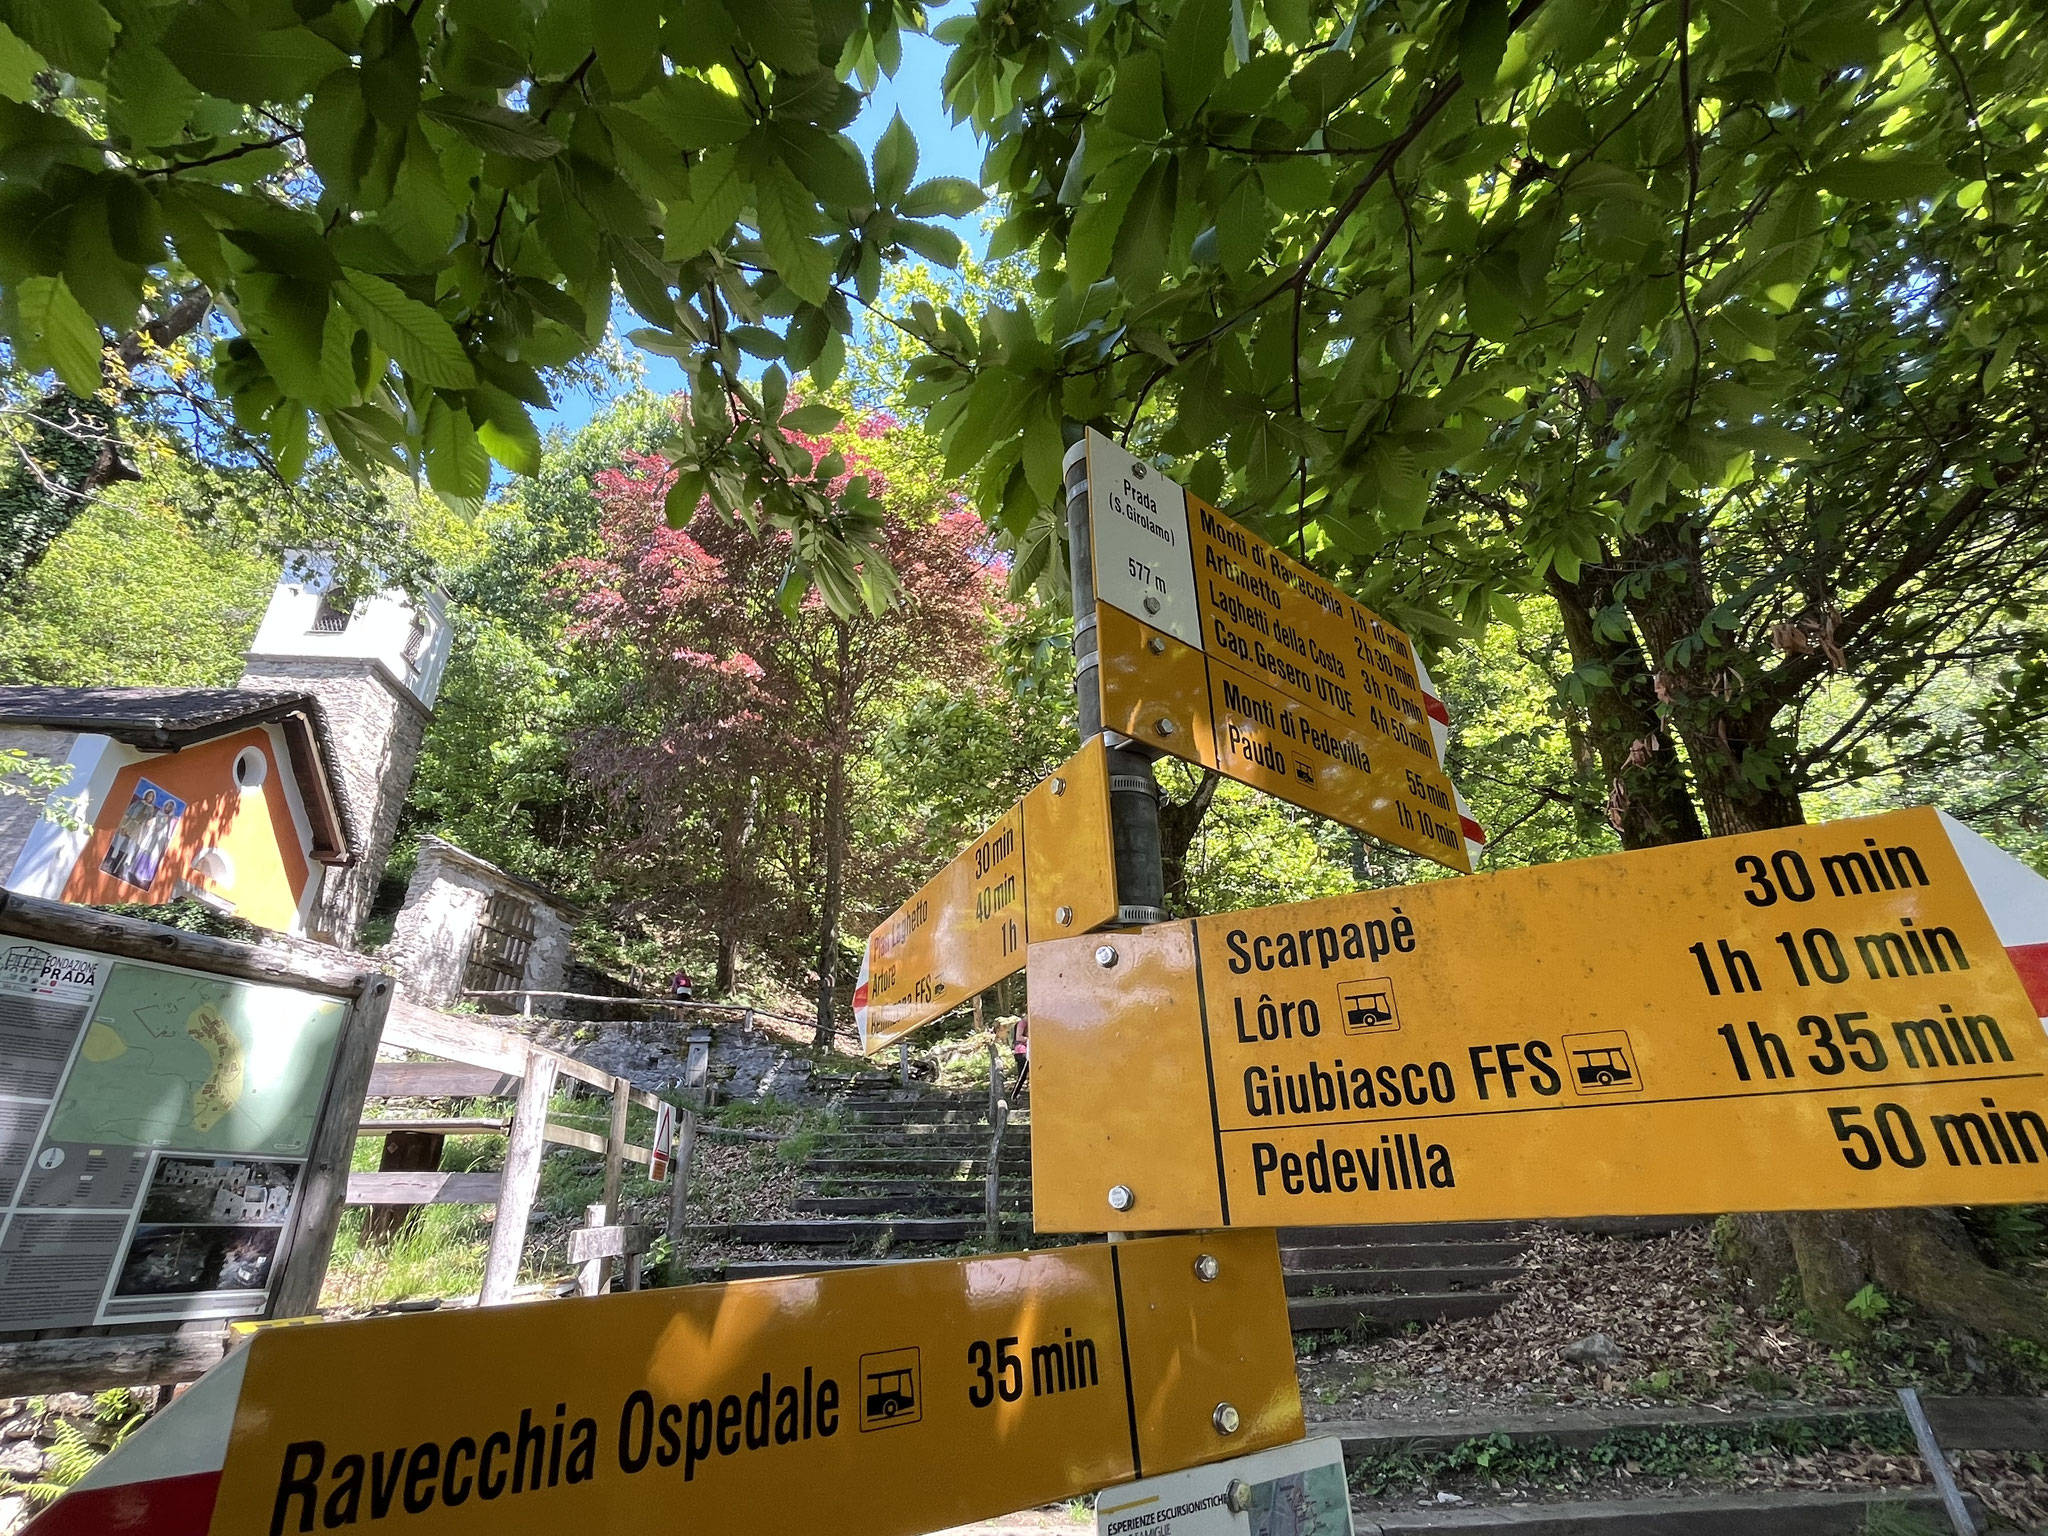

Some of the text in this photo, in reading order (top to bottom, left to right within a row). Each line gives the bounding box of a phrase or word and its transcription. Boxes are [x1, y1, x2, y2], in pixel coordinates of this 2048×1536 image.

[1123, 479, 1158, 514] Prada
[1128, 557, 1167, 594] 577 m
[1199, 508, 1409, 660] Monti di Ravecchia 1h 10 min
[1205, 545, 1282, 610] Arbinetto
[1375, 649, 1393, 677] 30
[1393, 665, 1416, 692] min
[1208, 580, 1424, 725] Laghetti della Costa 3h 10 min
[1214, 619, 1433, 759] Cap. Gesero UTOE 4h 50 min
[1222, 679, 1451, 812] Monti di Pedevilla 55 min
[1228, 723, 1460, 851] Paudo 1h 10 min
[975, 841, 991, 880] 30
[992, 827, 1014, 867] min
[1225, 838, 1931, 975] Scarpapè 30 min
[39, 966, 95, 986] PRADA
[44, 955, 99, 974] FONDAZIONE
[871, 873, 1016, 1001] Artore 40 min
[915, 973, 932, 1010] FFS
[1233, 917, 1971, 1044] Lôro 1h 10 min
[1243, 1004, 2016, 1117] Giubiasco FFS 1h 35 min
[1251, 1097, 2048, 1197] Pedevilla 50 min
[267, 1327, 1100, 1536] Ravecchia Ospedale 35 min
[1107, 1512, 1156, 1536] ESPERIENZE
